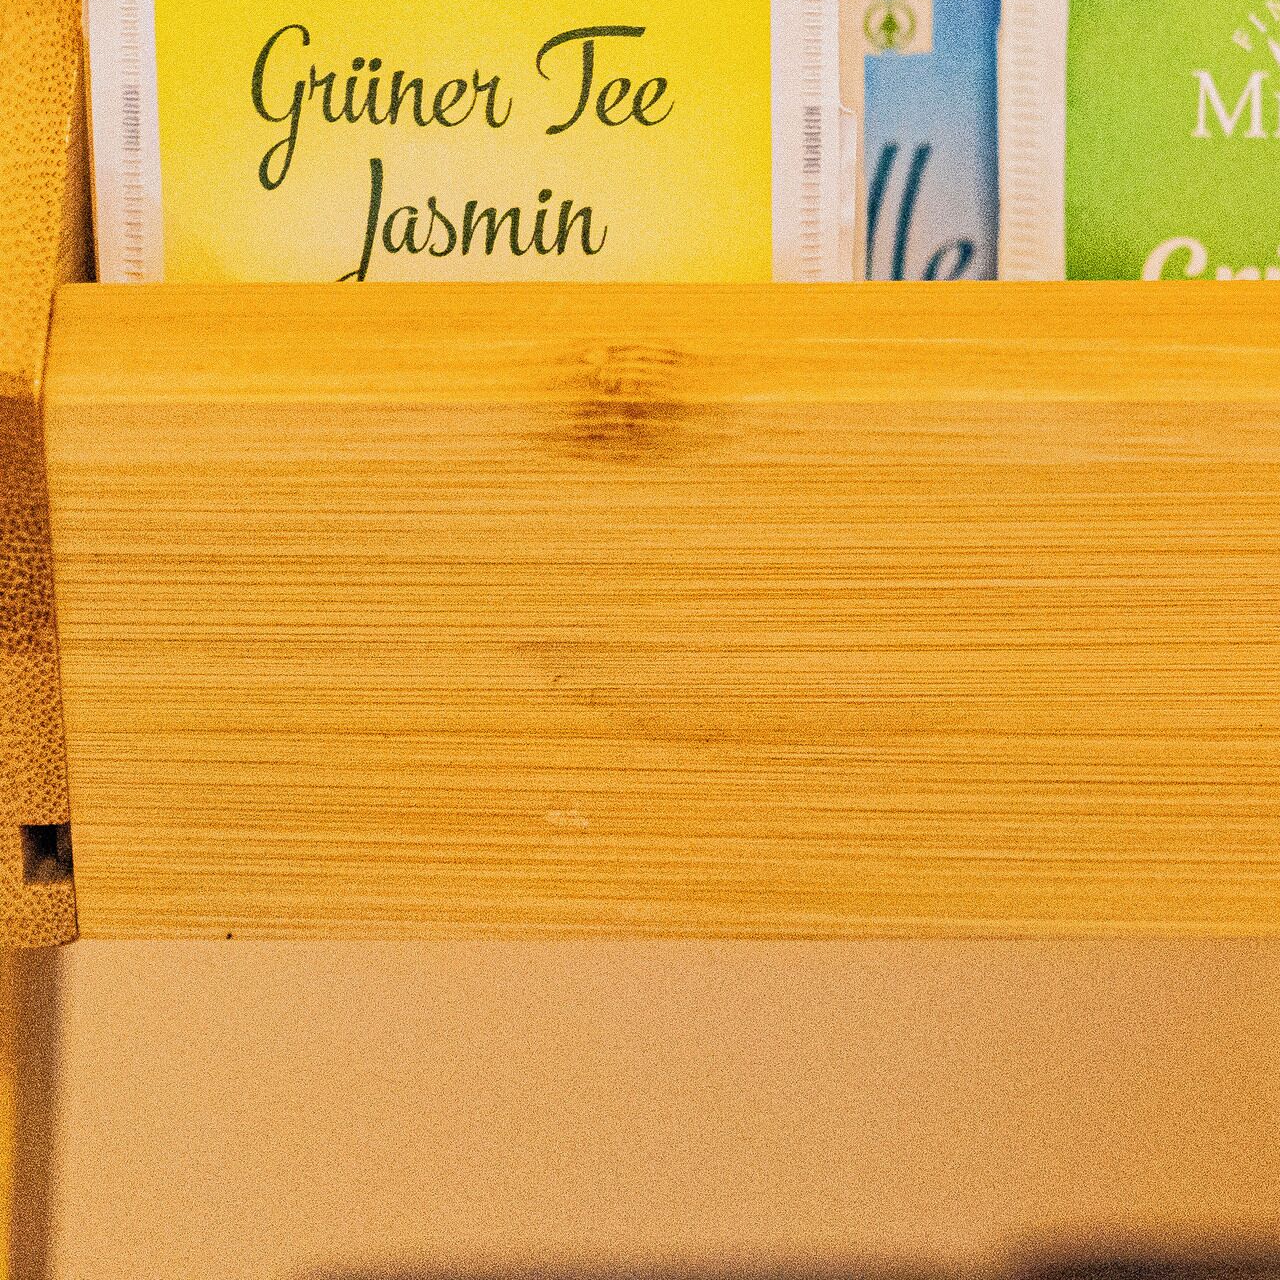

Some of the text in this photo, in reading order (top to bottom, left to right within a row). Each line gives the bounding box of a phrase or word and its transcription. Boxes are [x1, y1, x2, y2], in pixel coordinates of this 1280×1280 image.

[251, 24, 675, 191] Grüner Tee
[336, 158, 607, 282] Jasmin
